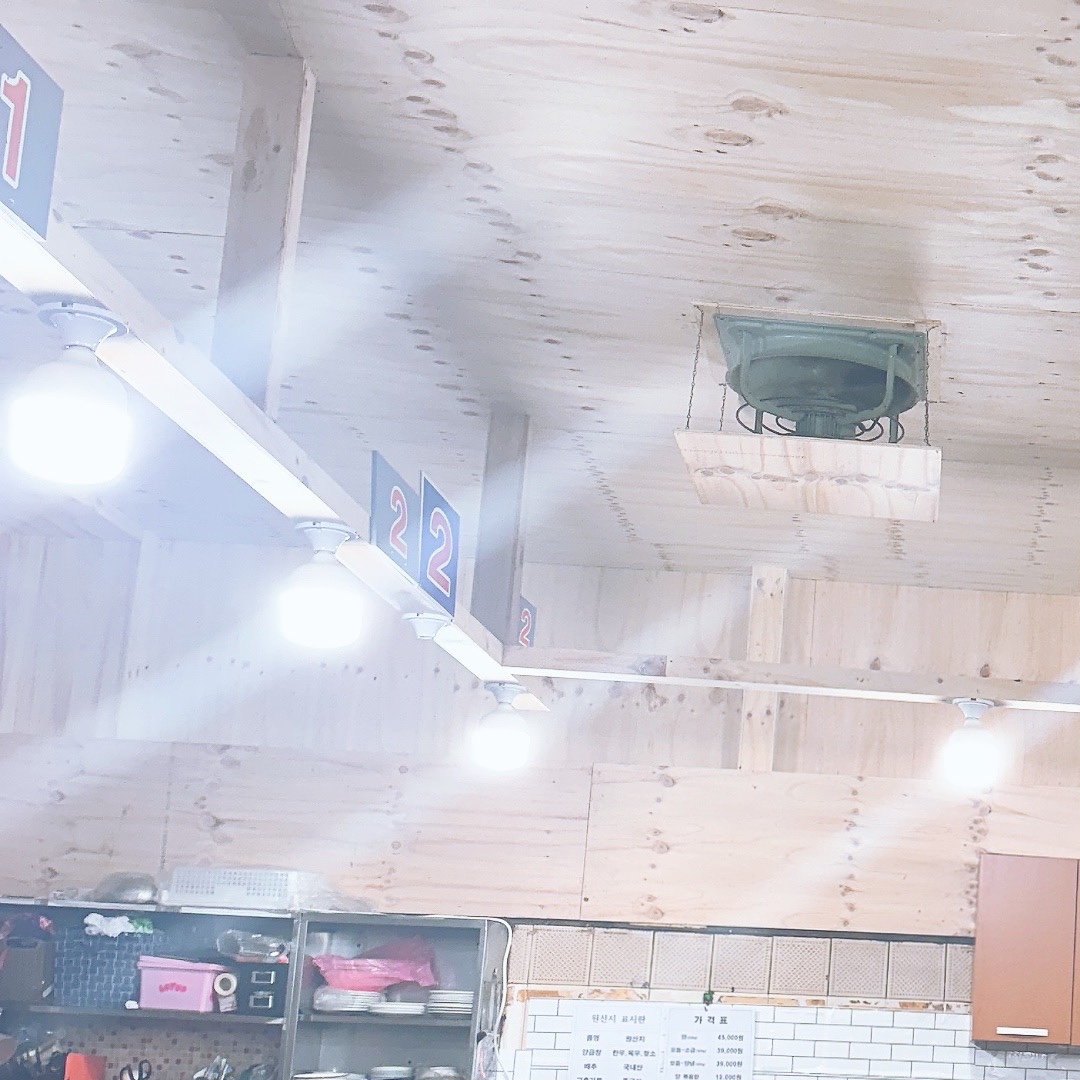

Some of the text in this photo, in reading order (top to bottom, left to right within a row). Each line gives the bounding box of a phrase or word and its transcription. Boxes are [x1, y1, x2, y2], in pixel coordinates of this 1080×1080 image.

[389, 485, 410, 560] 2
[427, 506, 453, 596] 2
[518, 608, 532, 647] 2
